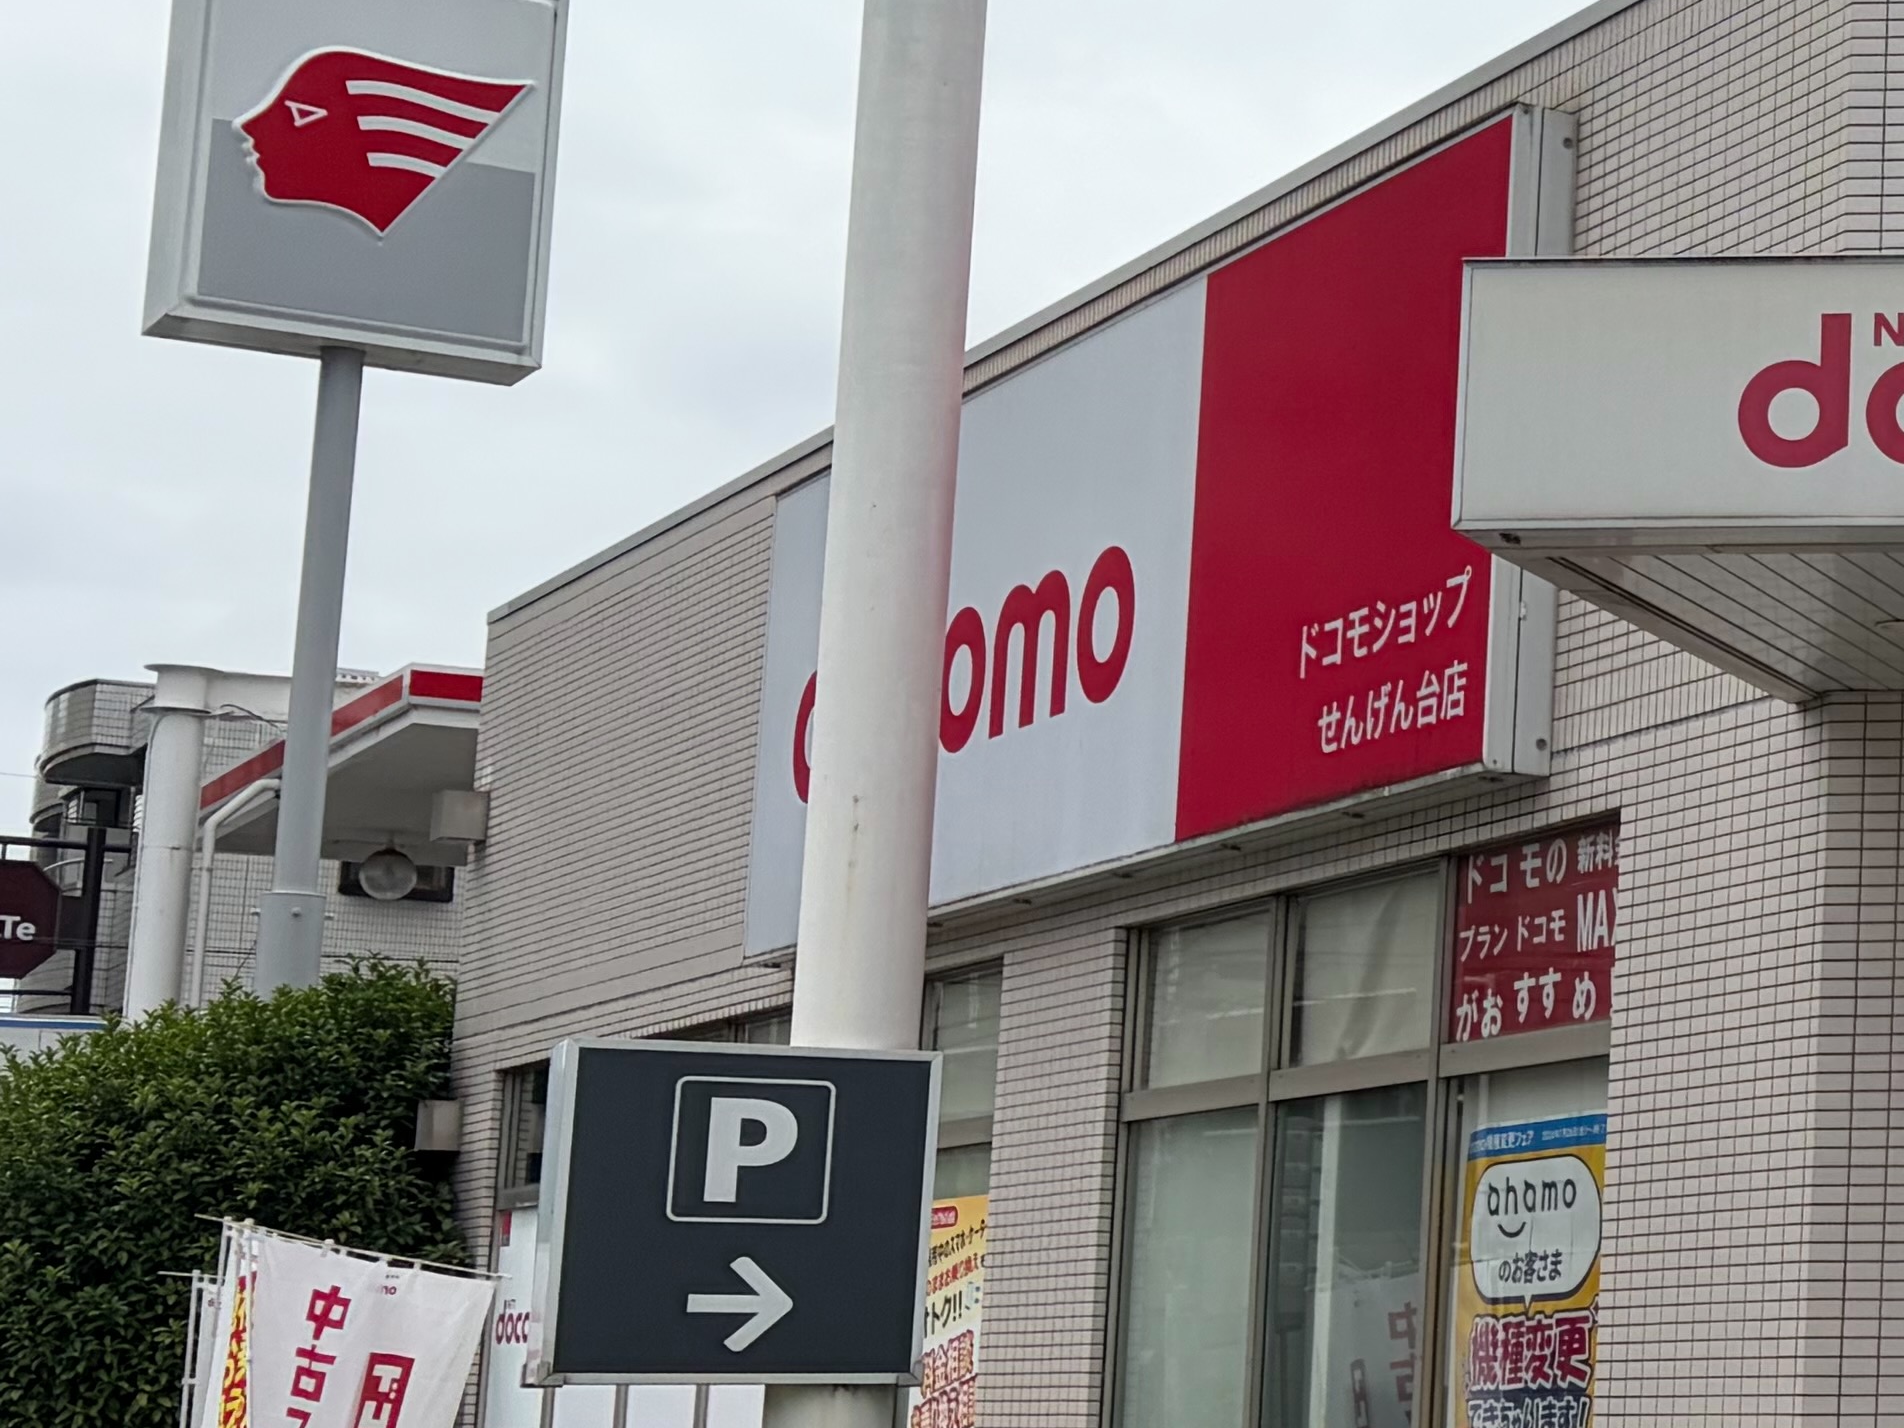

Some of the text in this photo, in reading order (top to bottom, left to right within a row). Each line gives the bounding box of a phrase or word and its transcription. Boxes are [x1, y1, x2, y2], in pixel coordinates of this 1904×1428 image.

[1299, 564, 1473, 679] ドコモショップ
[1317, 661, 1469, 755] せんげん台店
[0, 914, 36, 942] Te
[703, 1096, 799, 1204] P
[1487, 1176, 1577, 1216] ahamo
[1498, 1248, 1563, 1284] のお客さま
[1471, 1314, 1592, 1390] 機種変更
